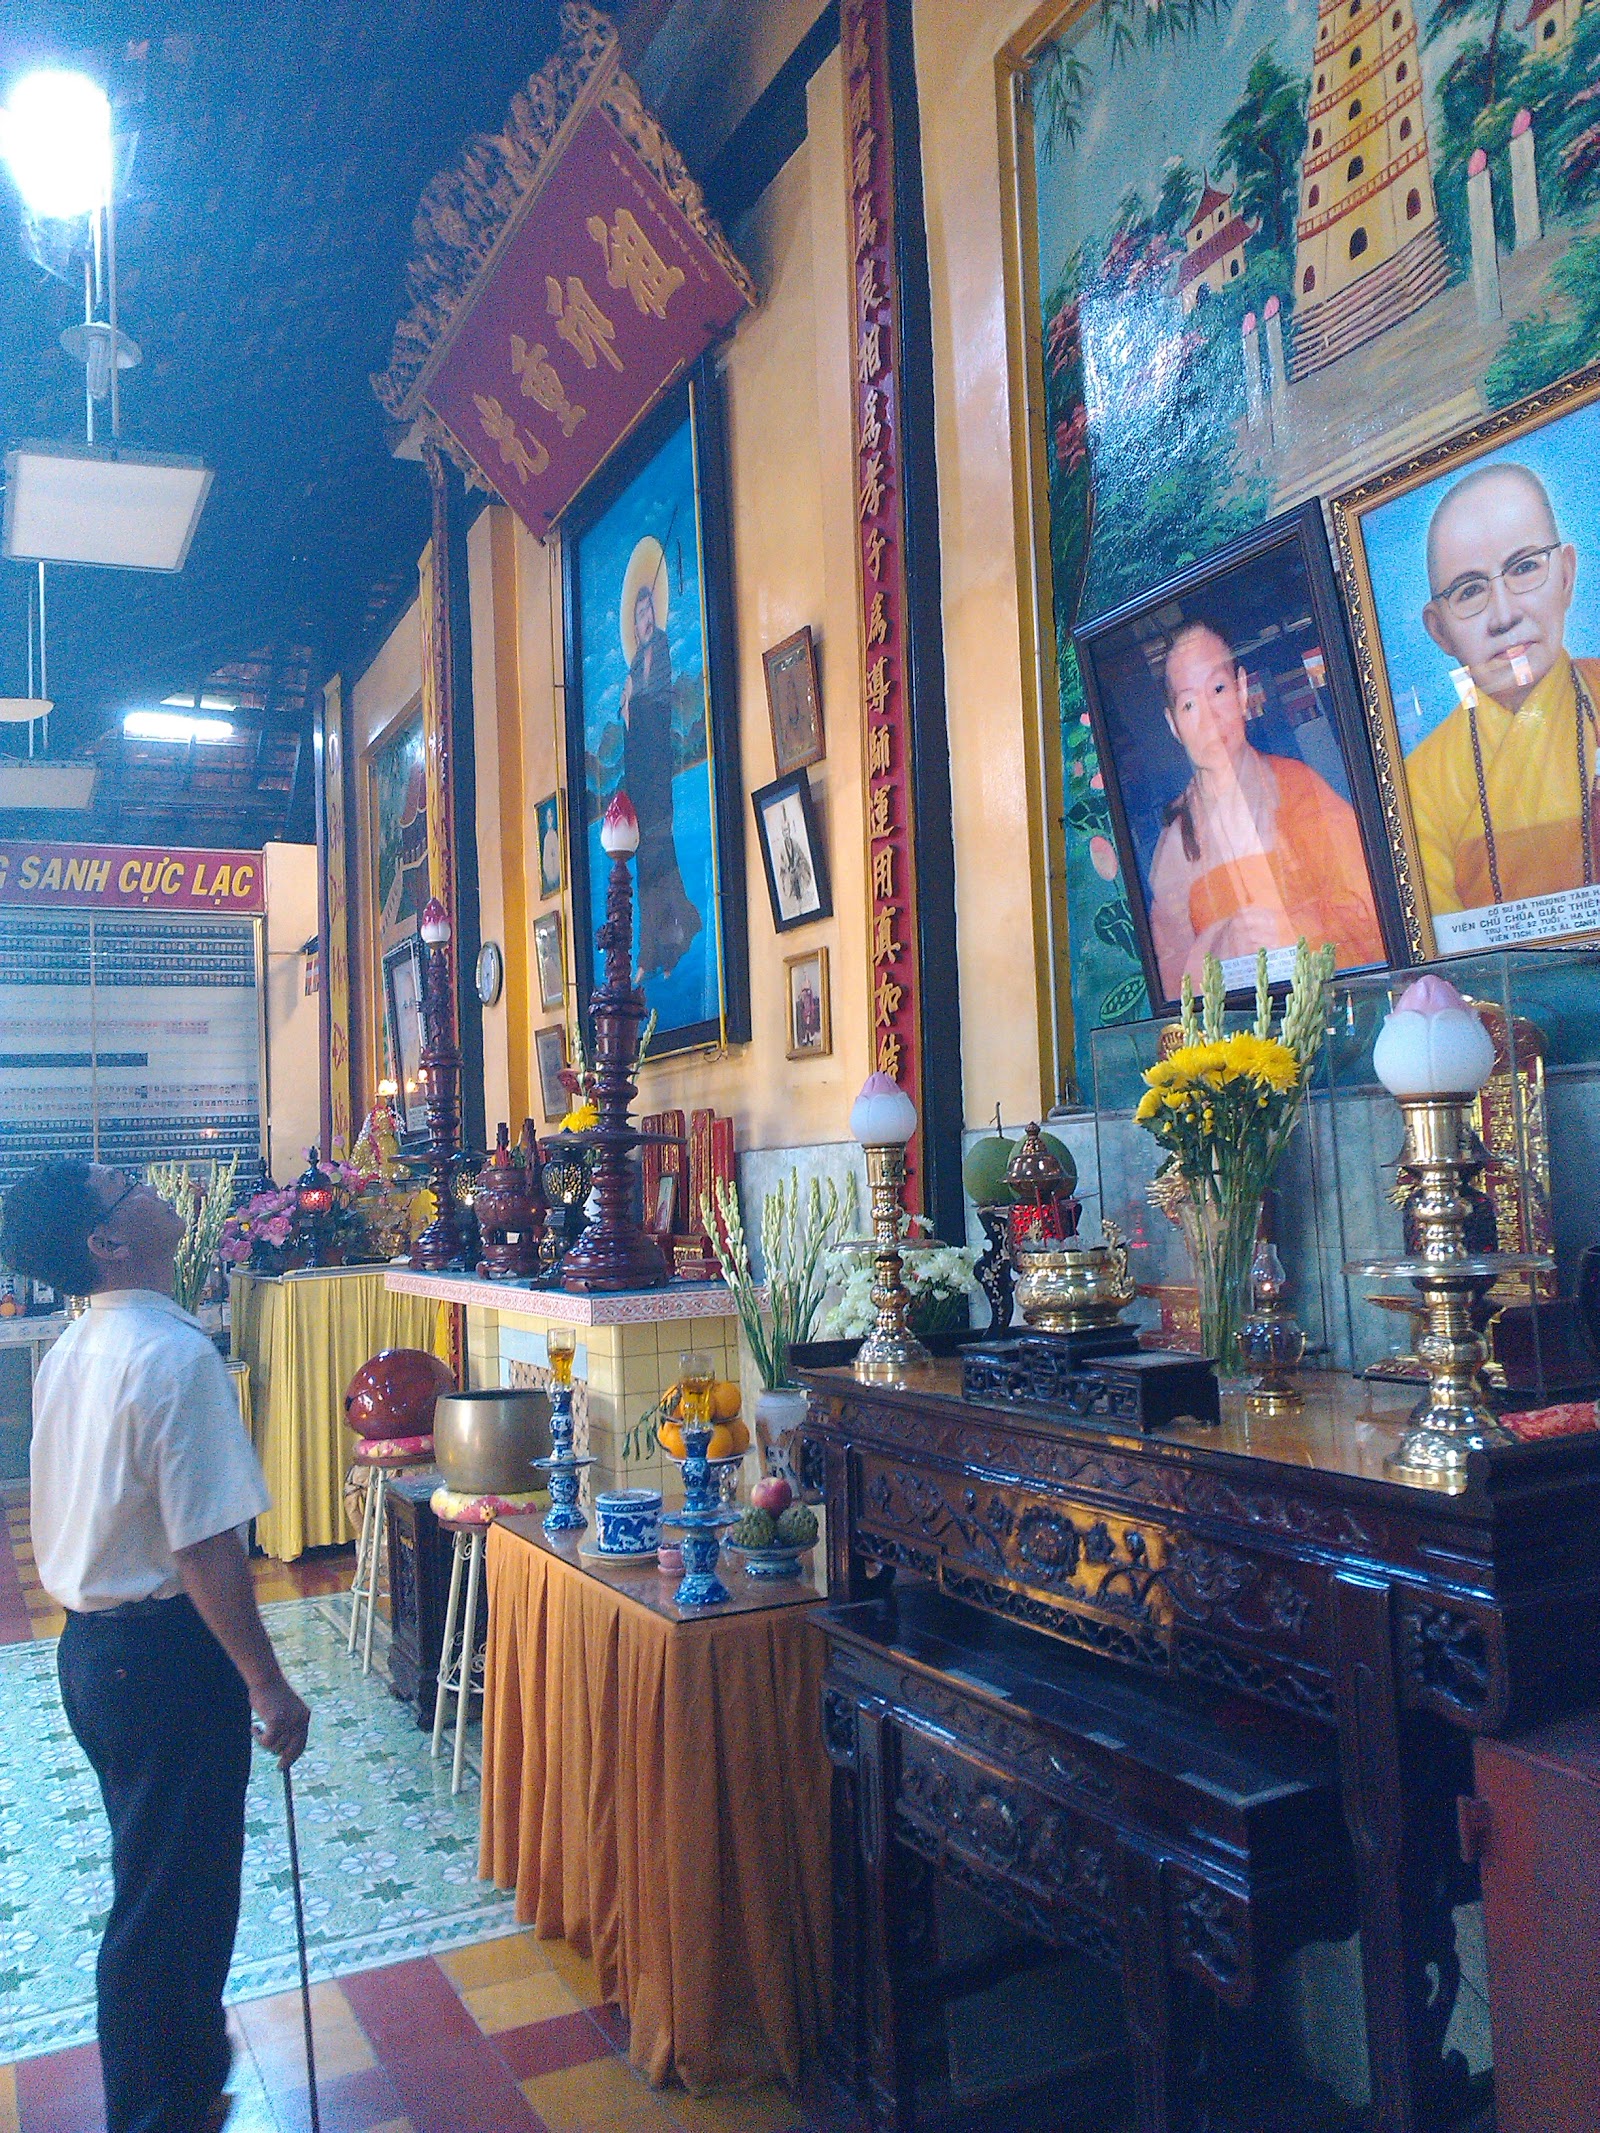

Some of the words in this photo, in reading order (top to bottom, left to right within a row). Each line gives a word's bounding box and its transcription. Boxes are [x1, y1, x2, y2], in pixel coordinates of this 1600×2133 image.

[18, 856, 112, 892] SANH
[119, 856, 184, 903] CỰC
[192, 863, 254, 905] LẠC
